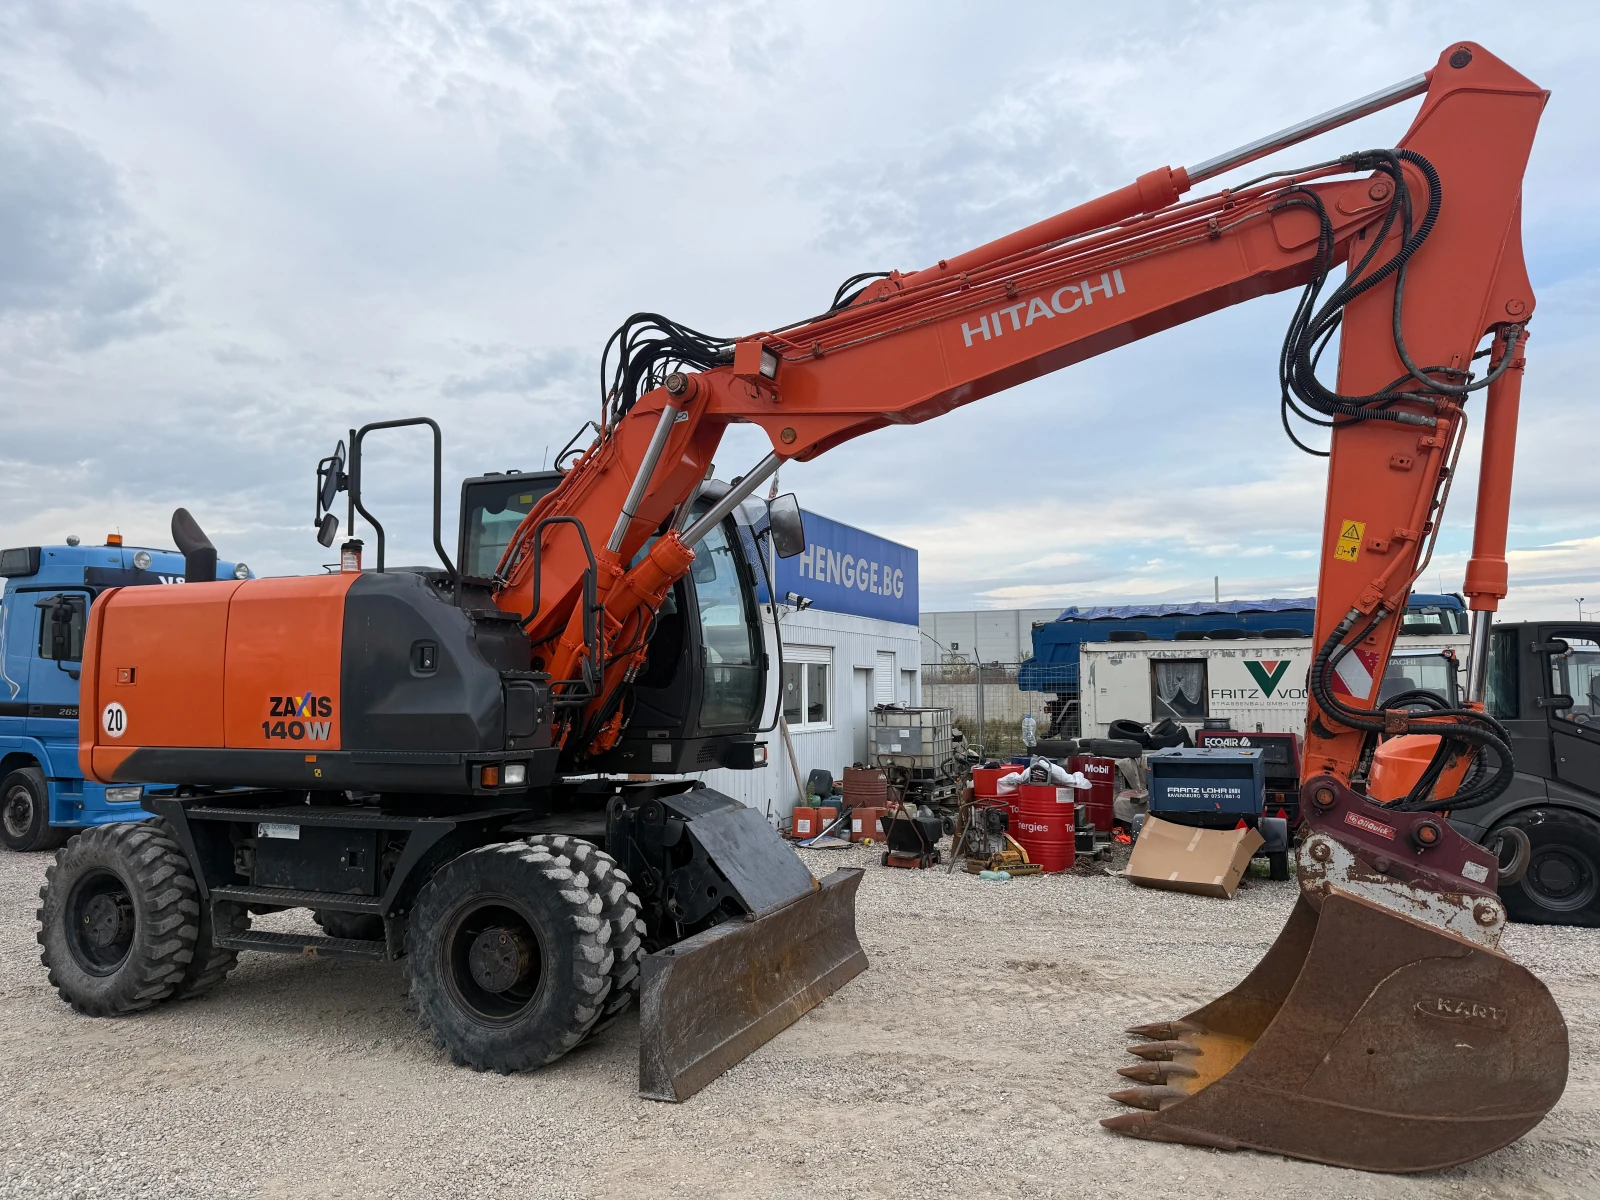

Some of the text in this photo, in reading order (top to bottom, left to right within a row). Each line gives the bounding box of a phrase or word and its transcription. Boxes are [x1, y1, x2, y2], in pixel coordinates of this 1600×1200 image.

[961, 269, 1126, 347] HITACHI
[800, 544, 904, 598] HENGGE.BG
[1211, 689, 1259, 699] FRITZ
[270, 692, 332, 717] ZAXIS
[107, 708, 122, 731] 20
[262, 721, 331, 740] 140W
[1204, 737, 1239, 747] ECOAIR
[1084, 764, 1109, 774] Mobil
[1357, 819, 1389, 835] OilQuick
[1438, 998, 1503, 1020] KART
